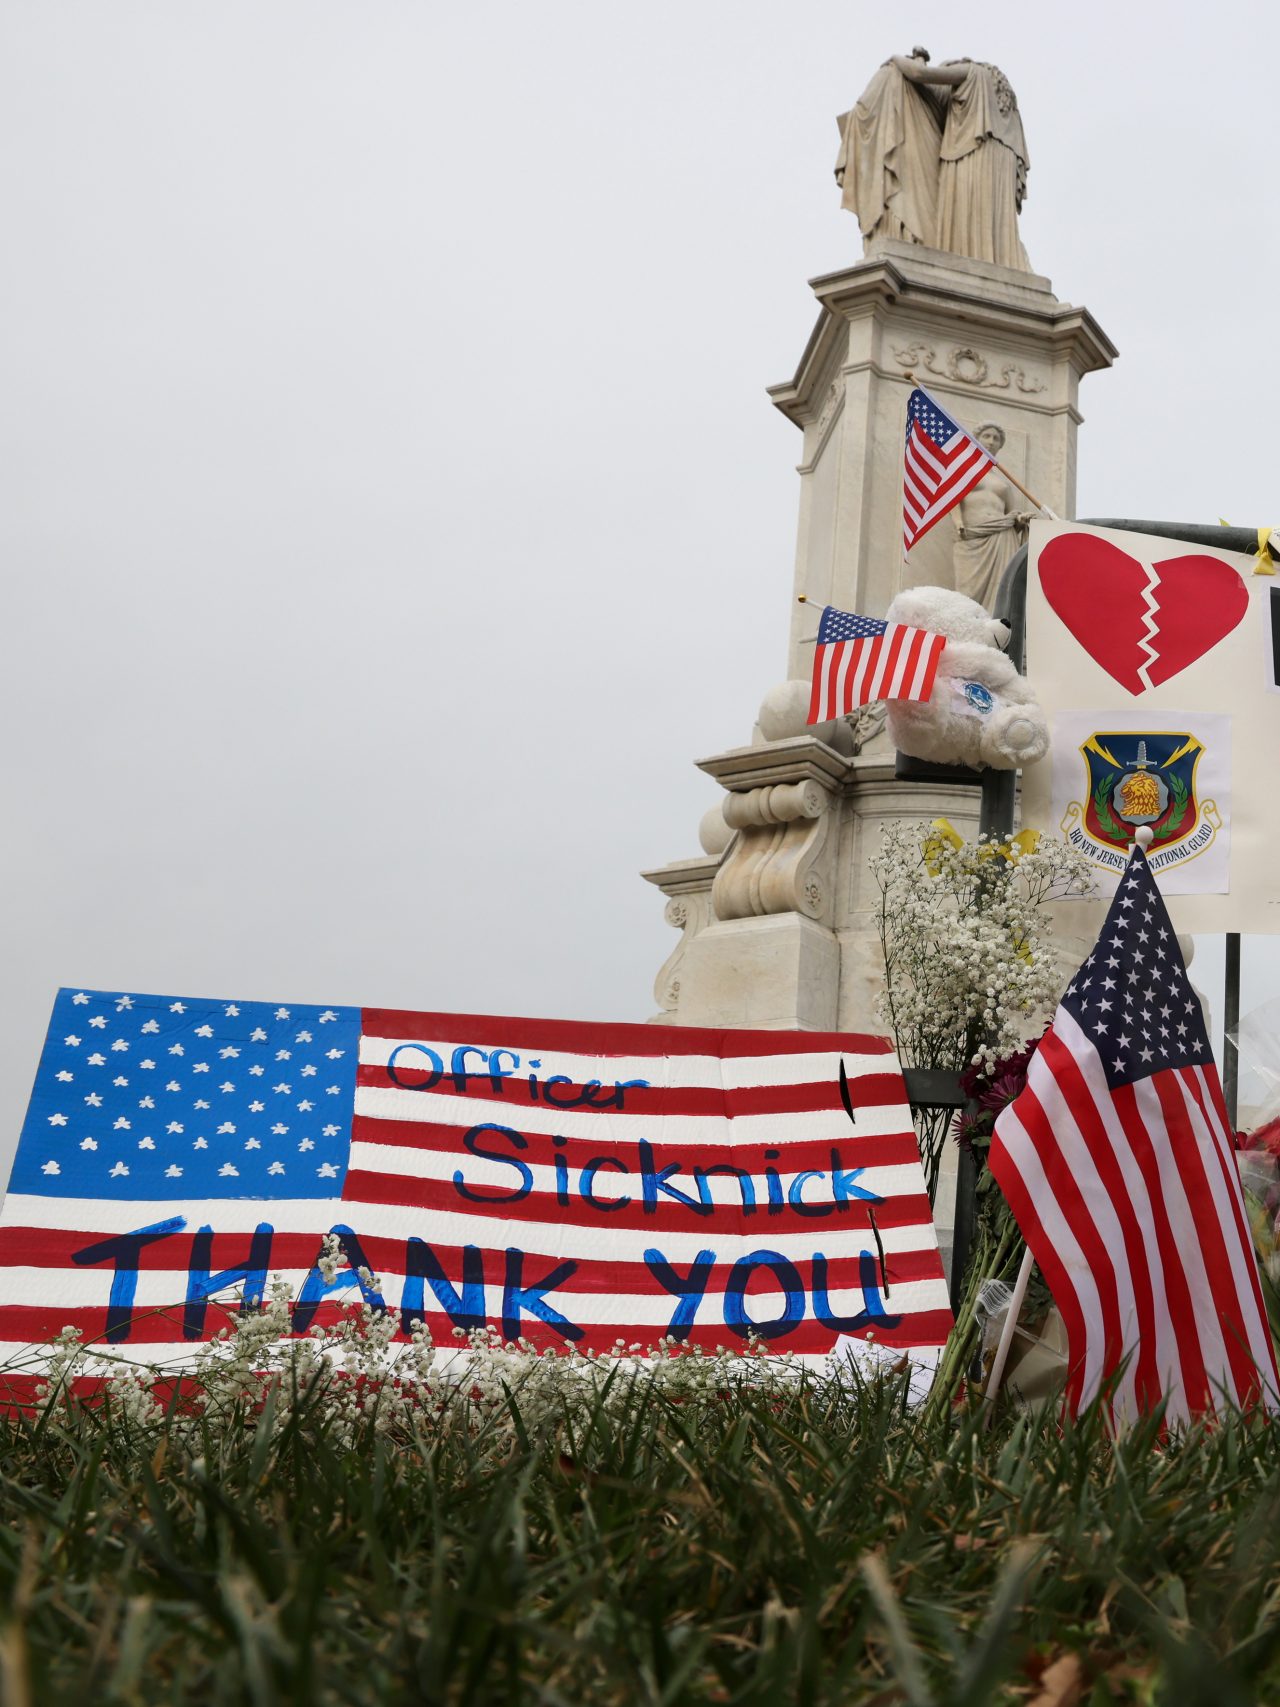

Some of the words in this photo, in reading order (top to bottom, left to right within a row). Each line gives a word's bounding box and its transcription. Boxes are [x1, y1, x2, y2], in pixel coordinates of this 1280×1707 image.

[1070, 827, 1082, 845] HQ
[1078, 839, 1099, 858] NEW
[1148, 848, 1189, 871] NATIONAL
[1188, 823, 1213, 852] GUARD
[386, 1042, 650, 1111] Officer
[453, 1122, 887, 1217] Sicknick
[71, 1215, 585, 1344] THANK
[643, 1247, 902, 1341] YOU
